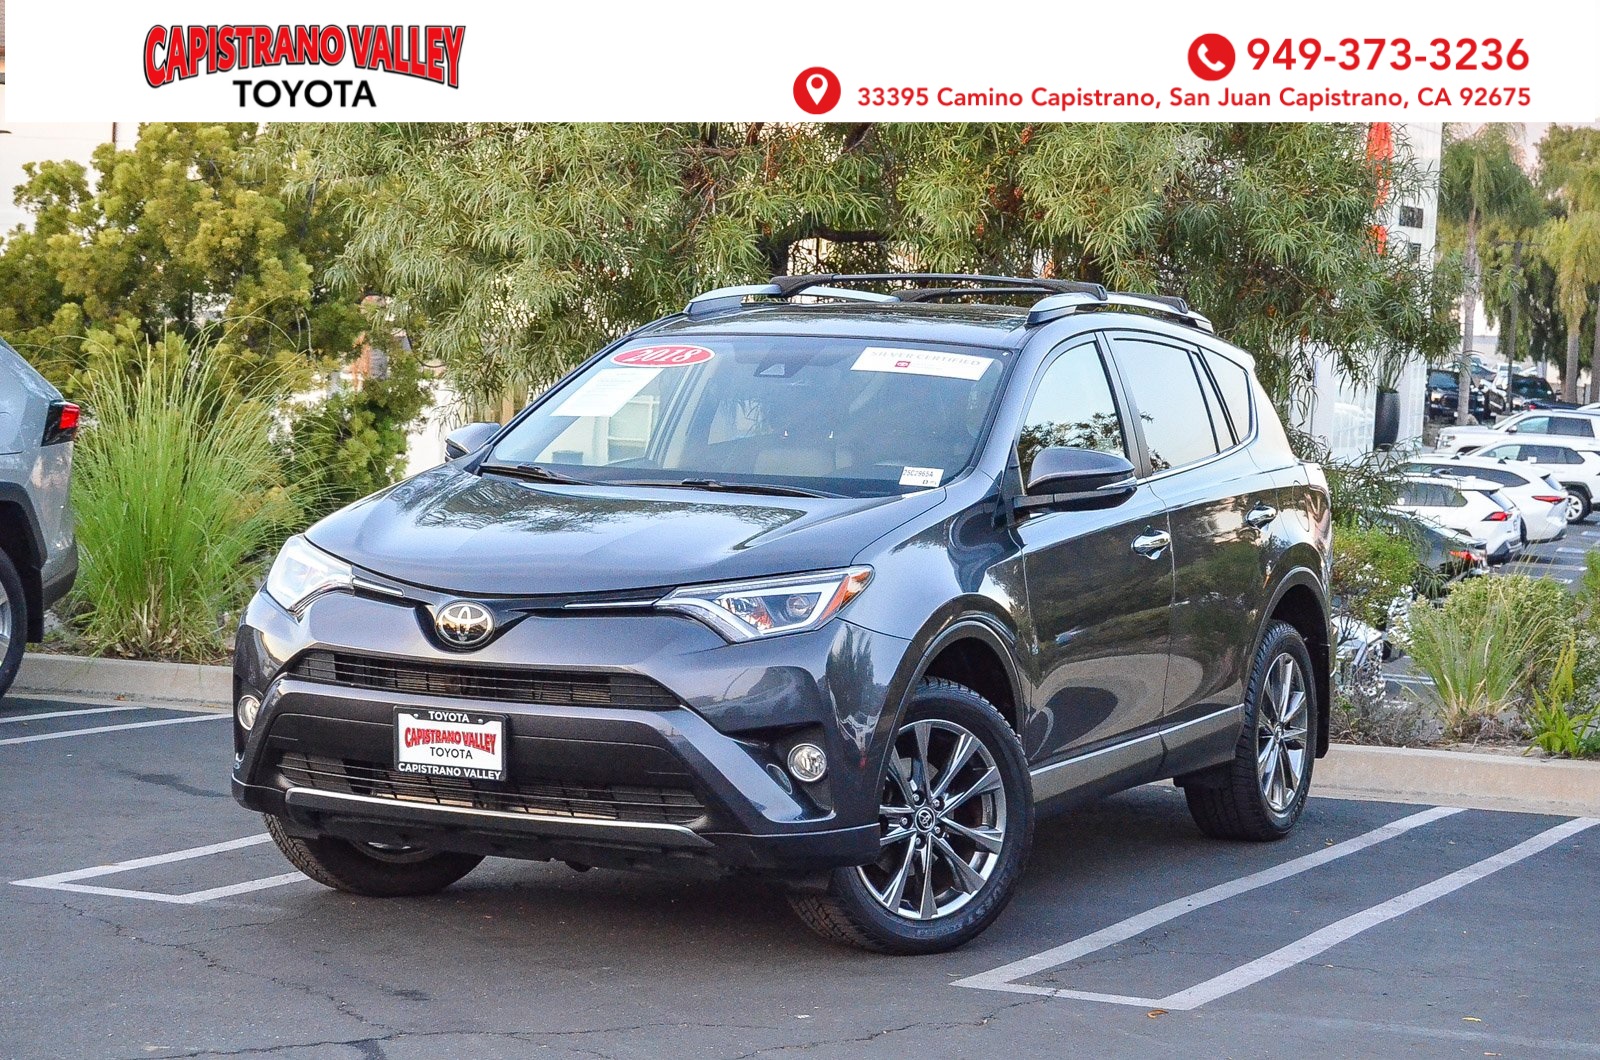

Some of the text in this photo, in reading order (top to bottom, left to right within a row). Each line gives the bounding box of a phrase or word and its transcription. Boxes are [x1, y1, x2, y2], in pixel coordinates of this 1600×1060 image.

[623, 348, 702, 363] 2018
[871, 350, 913, 360] SILVER
[916, 353, 981, 367] CERTIFIED
[428, 711, 470, 723] TOYOTA
[404, 727, 497, 755] CAPISTRANO VALLEY
[430, 747, 473, 759] TOYOTA
[398, 762, 502, 780] CAPISTRANO VALLEY
